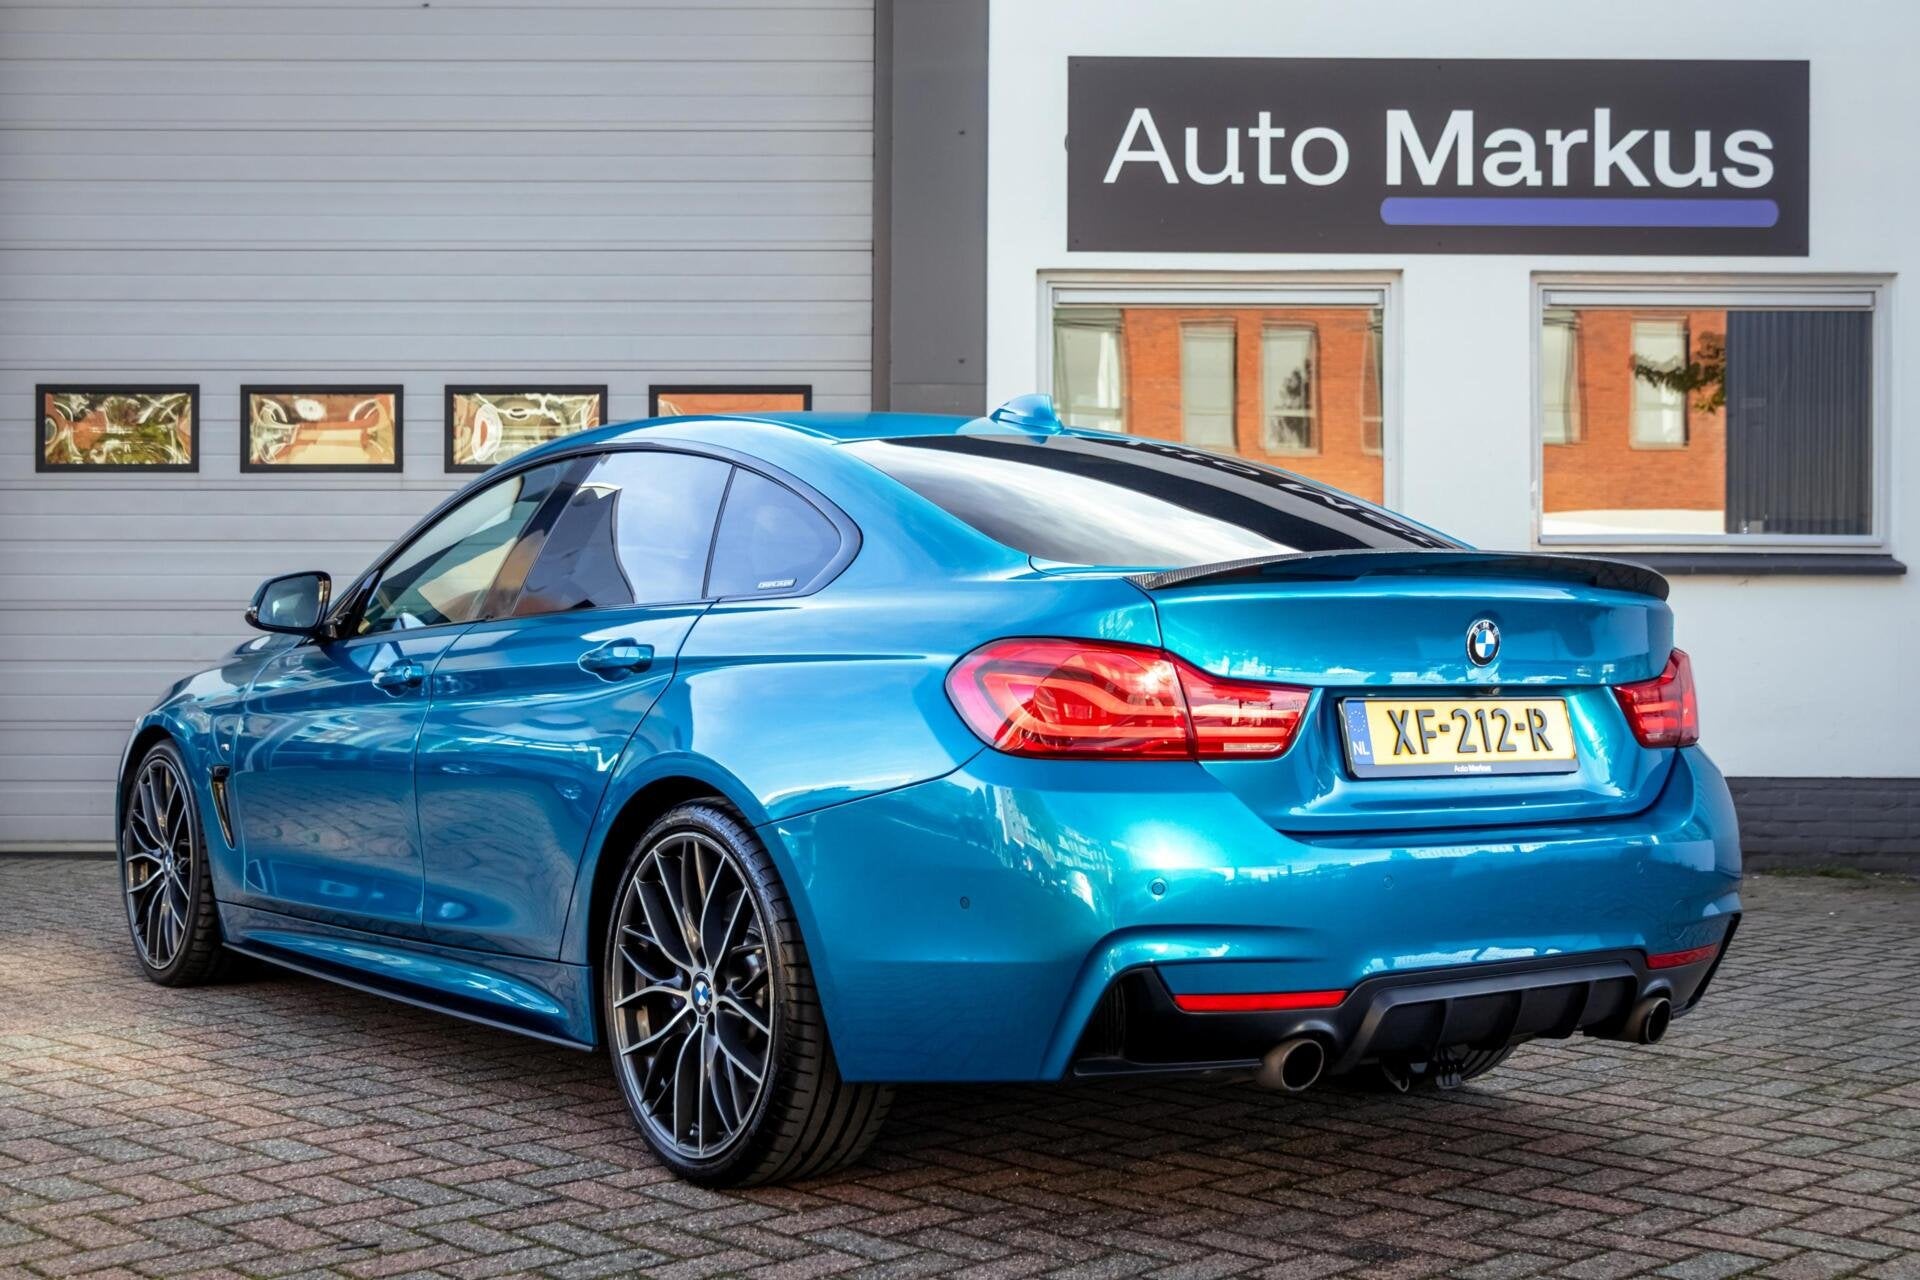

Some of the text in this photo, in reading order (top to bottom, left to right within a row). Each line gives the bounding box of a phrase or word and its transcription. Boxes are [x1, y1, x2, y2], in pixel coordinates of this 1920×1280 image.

[1103, 107, 1775, 189] Auto Markus
[1352, 740, 1371, 756] NL
[1387, 708, 1554, 756] XF-212-R
